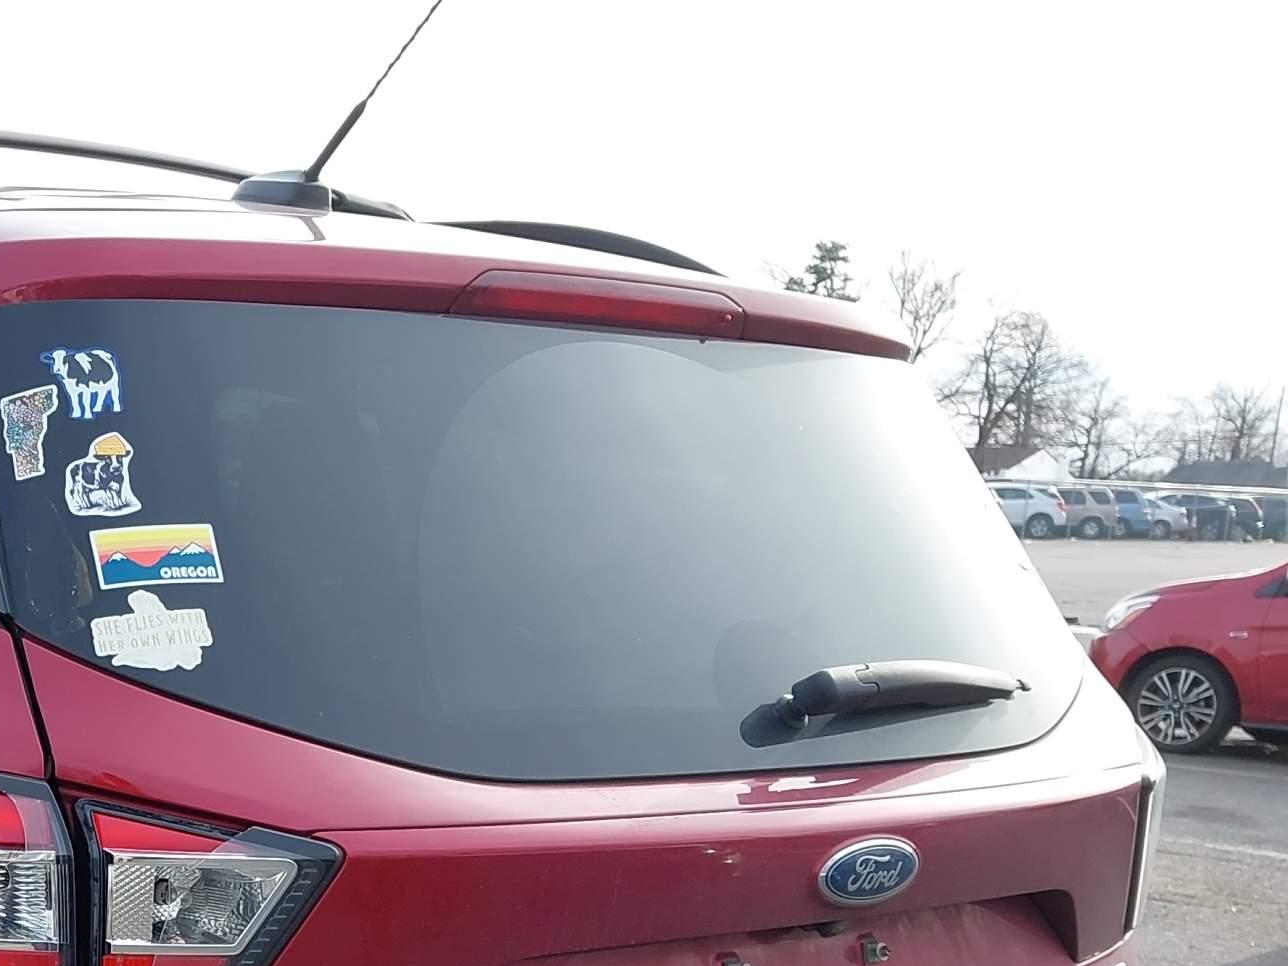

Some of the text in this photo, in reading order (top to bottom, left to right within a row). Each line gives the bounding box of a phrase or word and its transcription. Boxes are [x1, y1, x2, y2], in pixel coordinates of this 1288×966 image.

[159, 566, 217, 578] OREGON
[95, 611, 203, 636] SHE FLIES WITH
[97, 627, 210, 654] HER OWN WINGS
[847, 855, 903, 892] Ford
